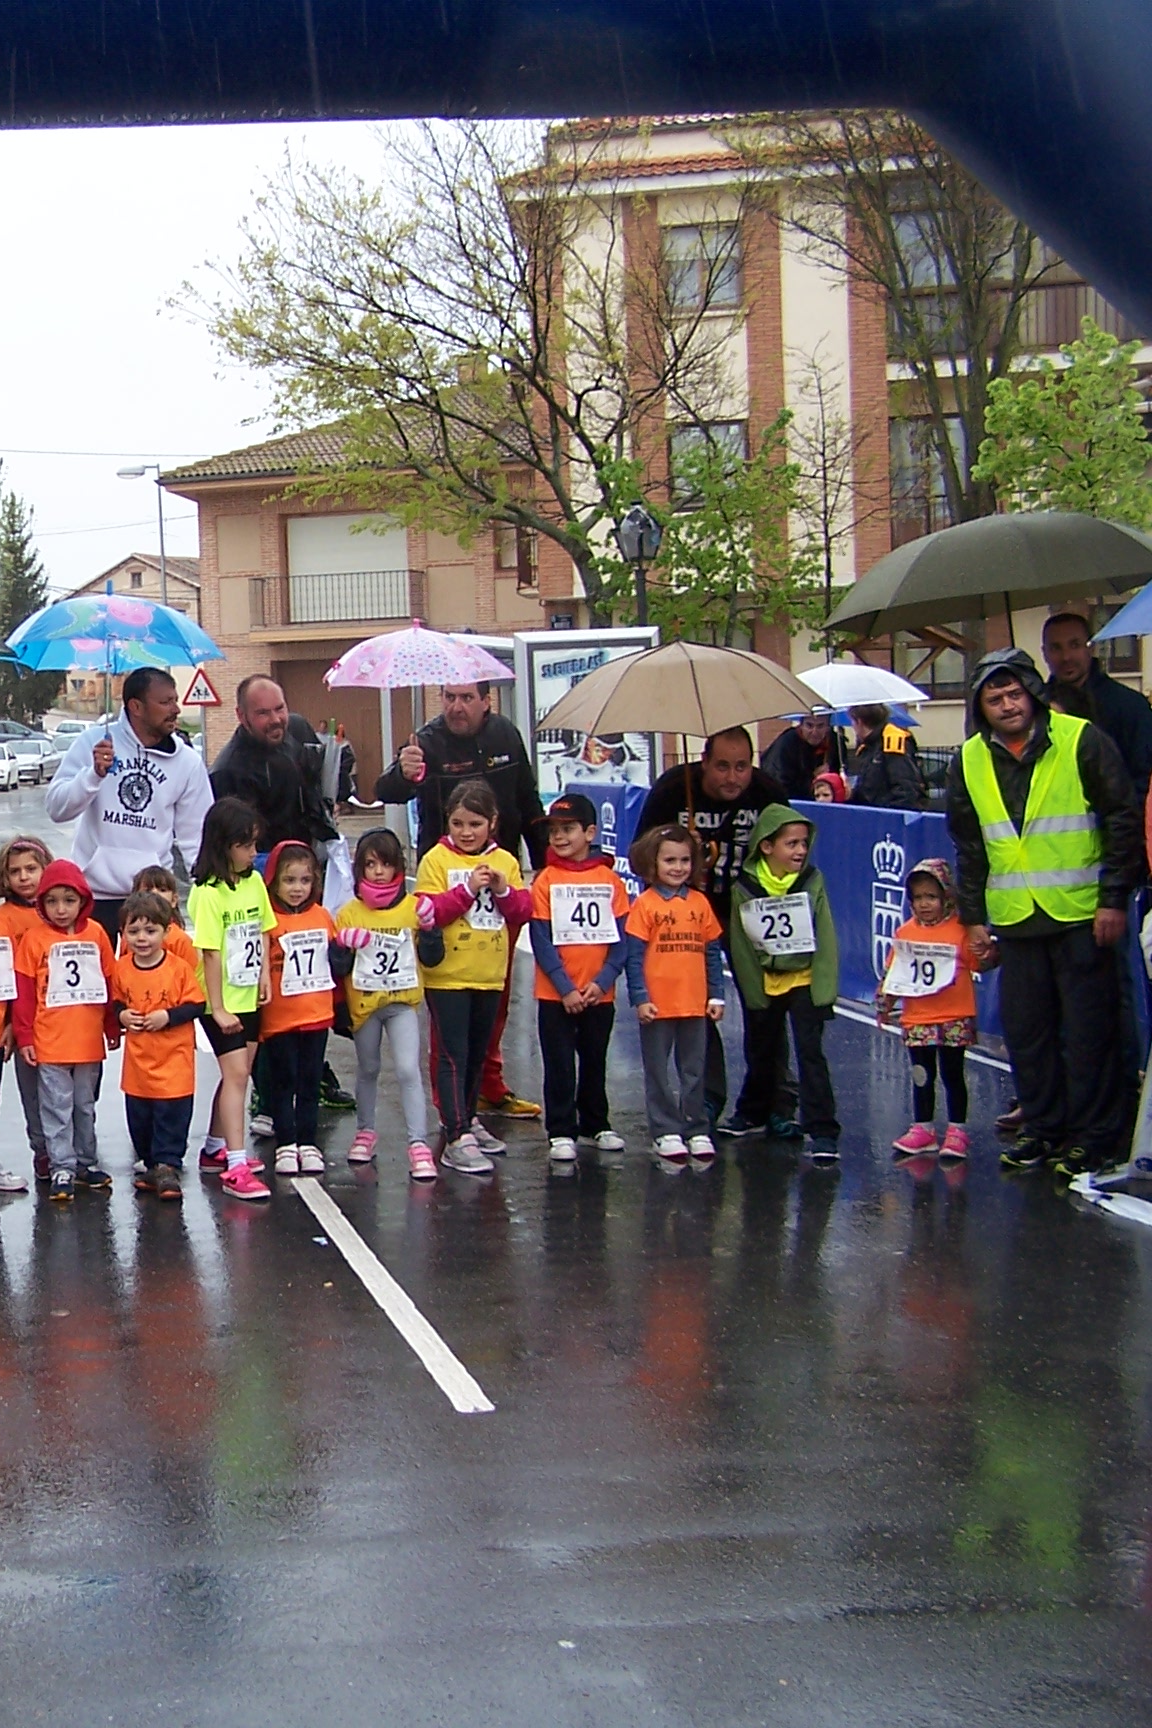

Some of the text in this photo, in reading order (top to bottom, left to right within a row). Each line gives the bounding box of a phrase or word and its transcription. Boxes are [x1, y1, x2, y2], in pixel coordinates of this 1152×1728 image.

[112, 757, 168, 784] RANKLIN
[678, 808, 759, 829] EOLUON
[570, 901, 600, 928] 40
[761, 912, 794, 940] 23
[65, 960, 81, 987] 3
[289, 948, 315, 977] 17
[372, 951, 400, 975] 32
[910, 958, 936, 986] 19
